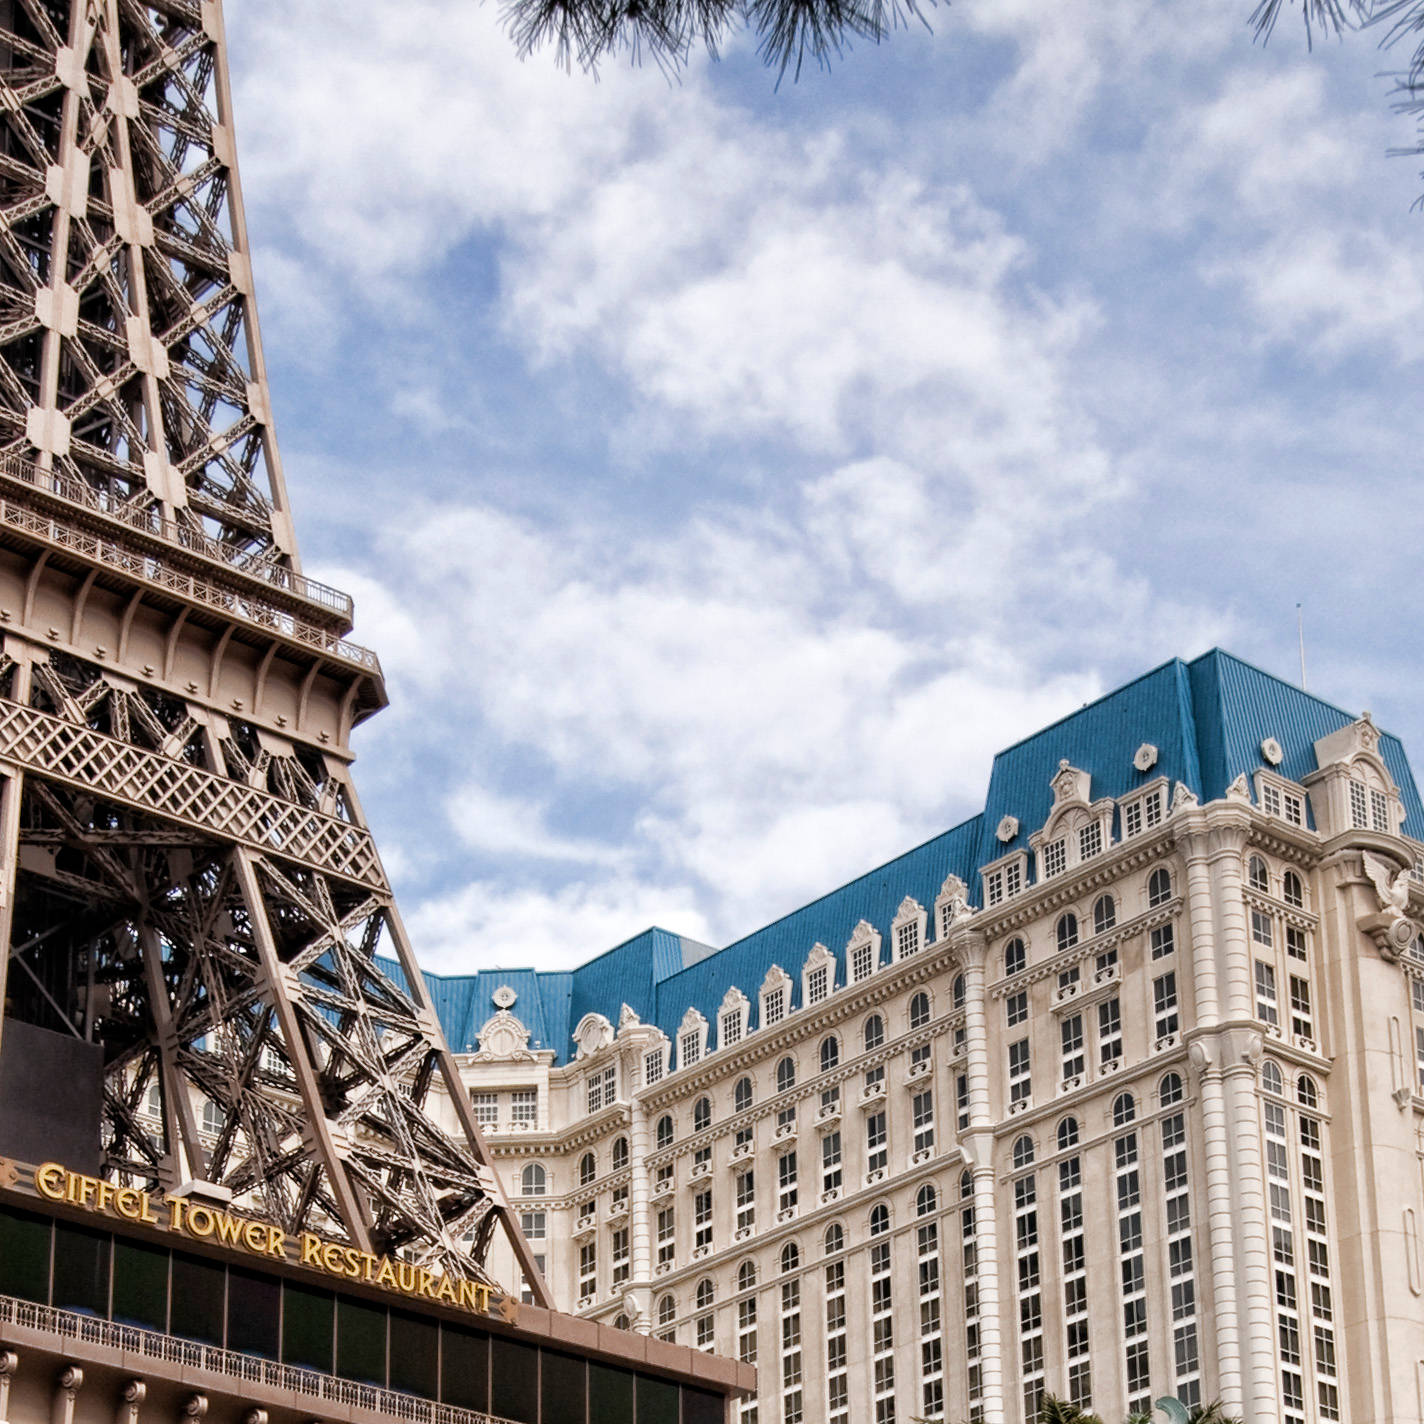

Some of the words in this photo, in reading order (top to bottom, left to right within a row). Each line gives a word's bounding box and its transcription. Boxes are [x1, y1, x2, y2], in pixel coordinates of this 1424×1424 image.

[35, 1161, 159, 1226] EIFFEL
[164, 1194, 287, 1259] TOWER
[299, 1232, 494, 1314] RESTAURANT
